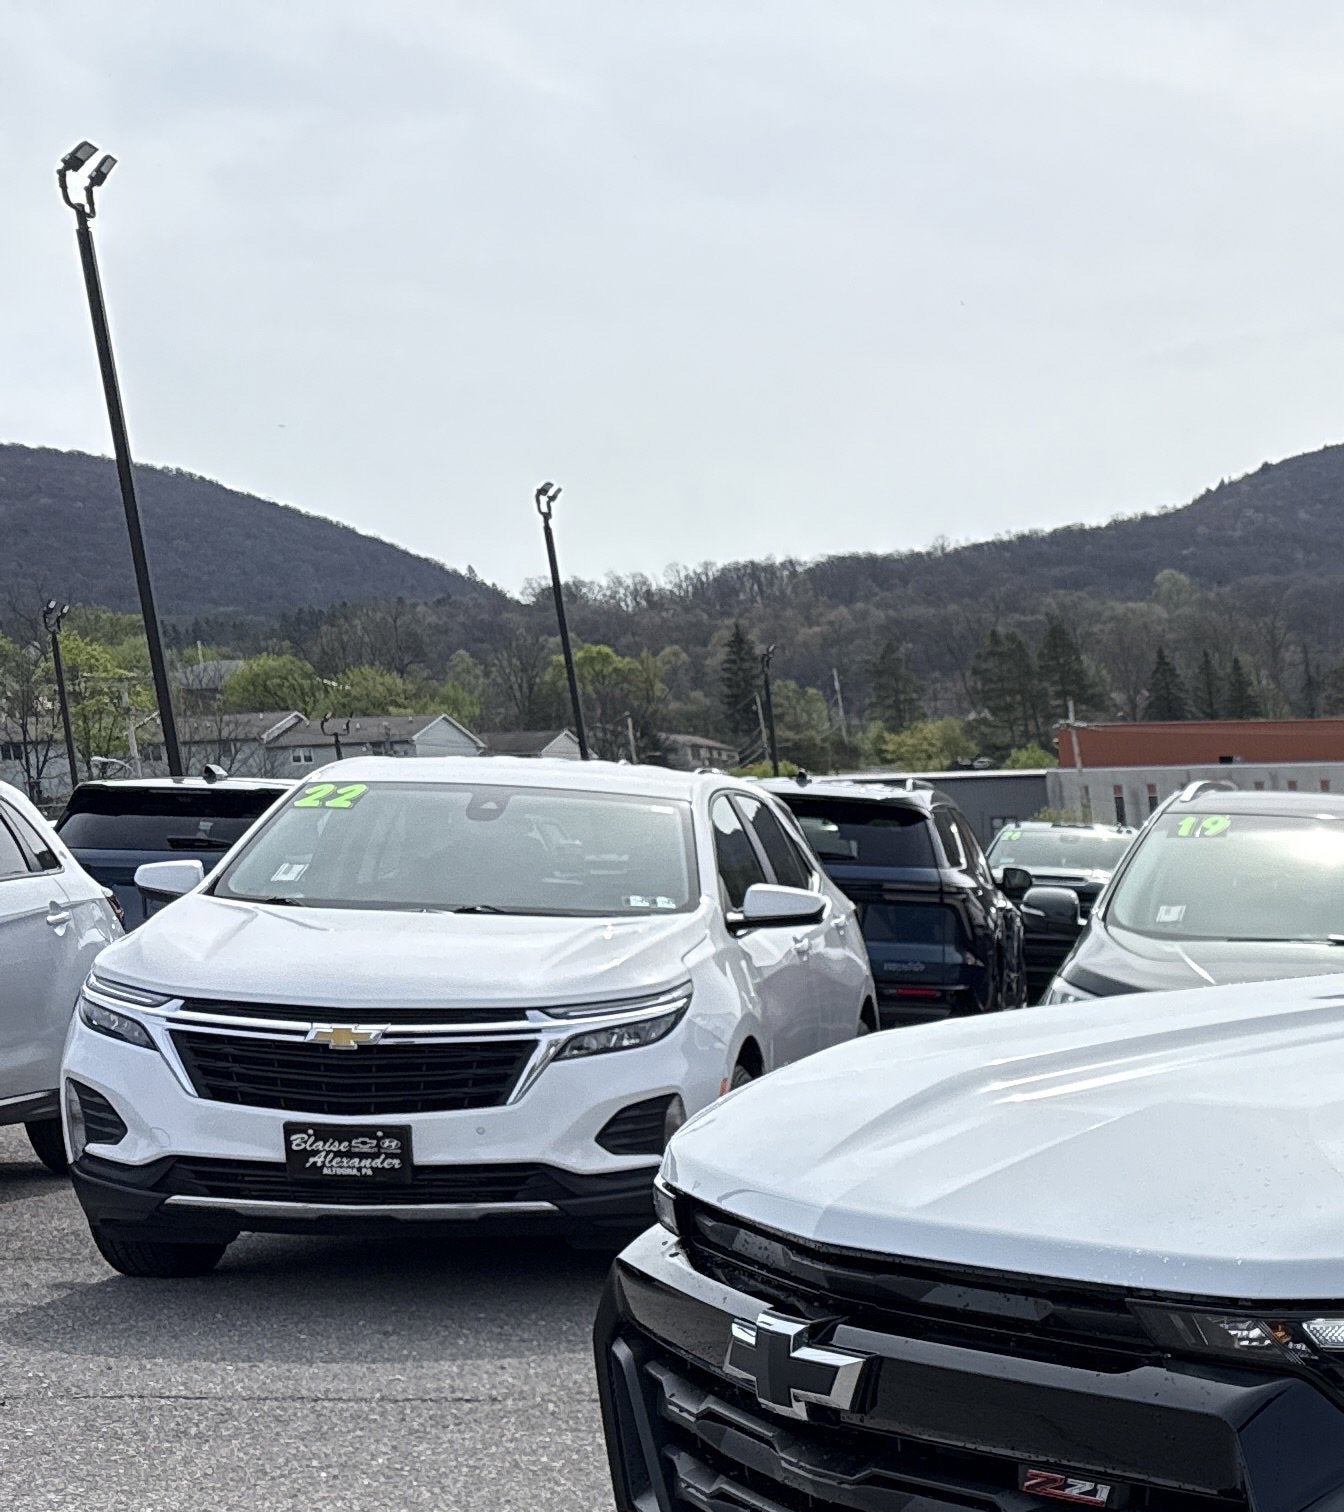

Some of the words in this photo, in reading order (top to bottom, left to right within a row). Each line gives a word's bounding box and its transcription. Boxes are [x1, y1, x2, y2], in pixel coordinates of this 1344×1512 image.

[293, 783, 368, 808] 22
[1177, 815, 1231, 836] 19
[290, 1133, 350, 1152] Blaise
[305, 1150, 402, 1169] Alexander
[1023, 1469, 1111, 1508] Z71
